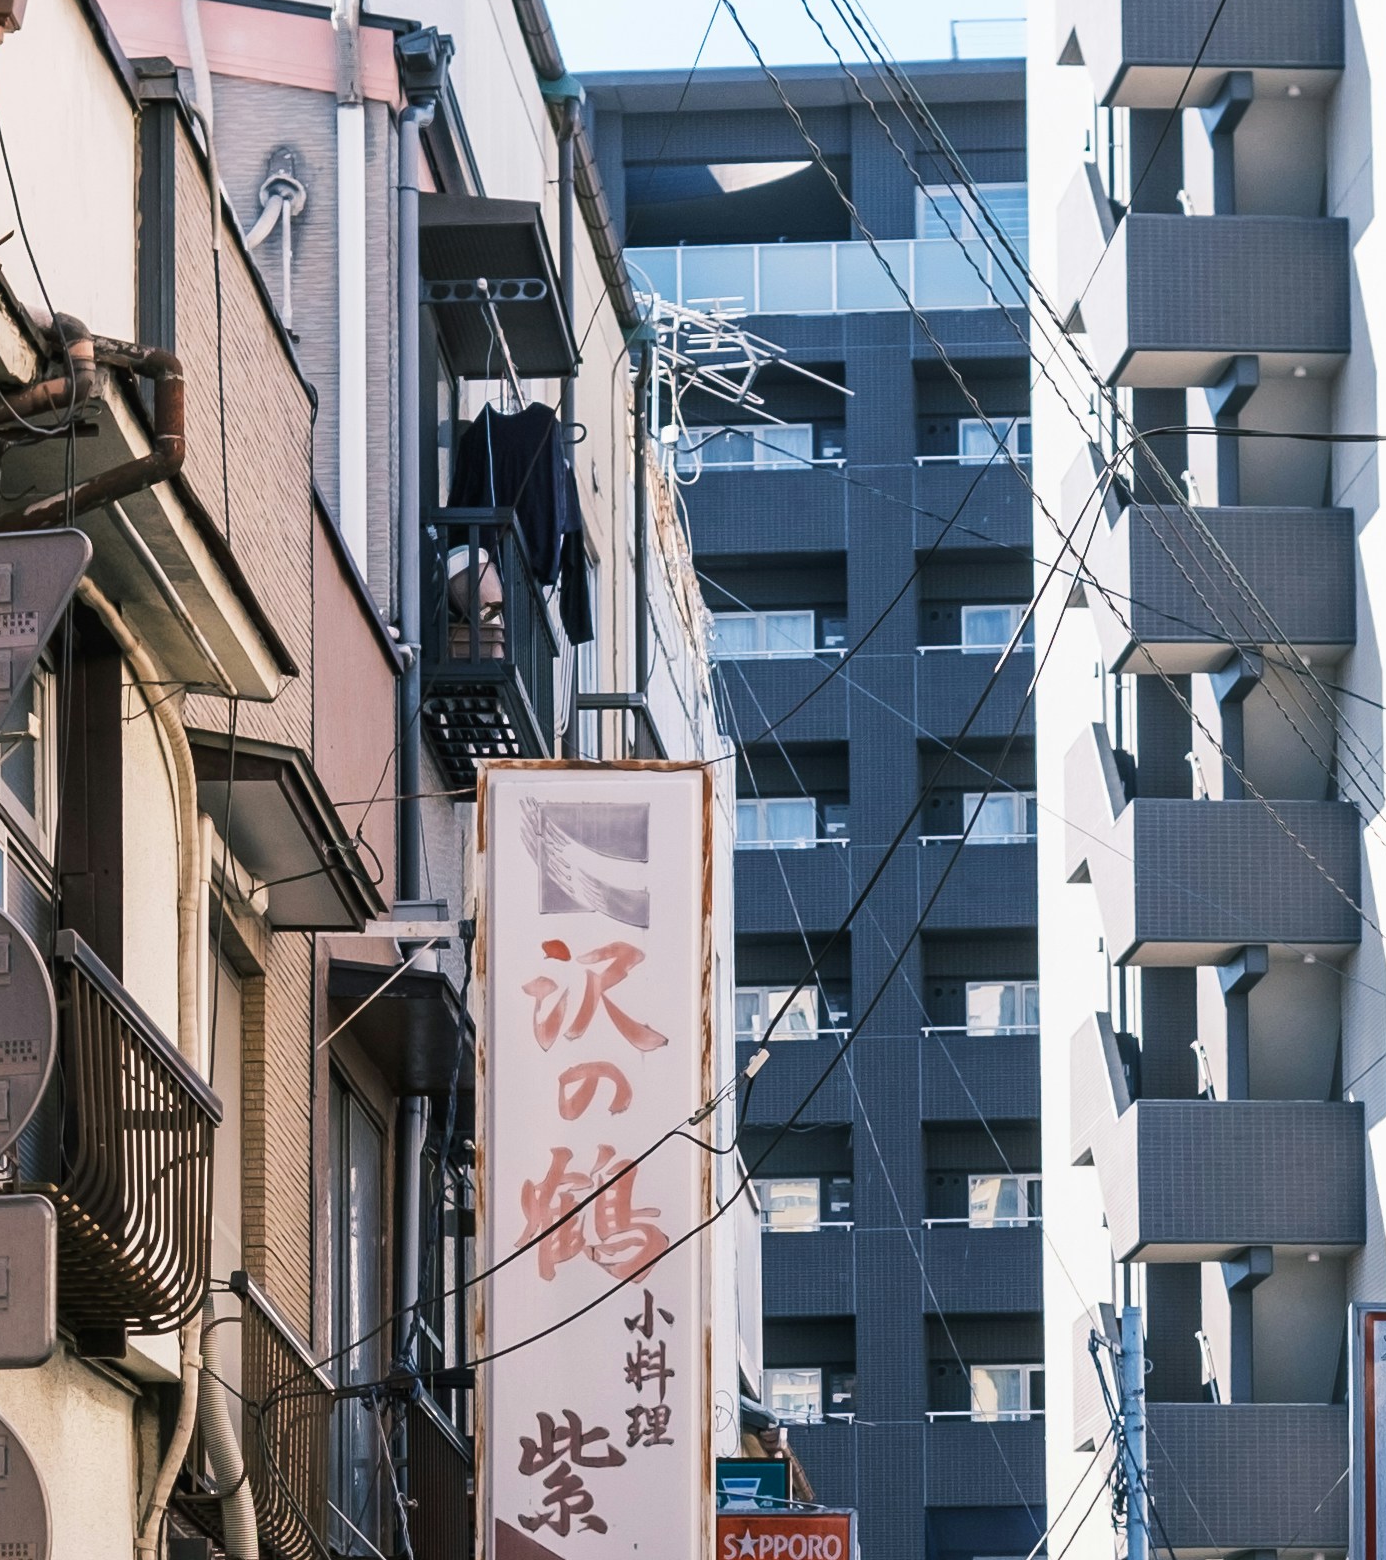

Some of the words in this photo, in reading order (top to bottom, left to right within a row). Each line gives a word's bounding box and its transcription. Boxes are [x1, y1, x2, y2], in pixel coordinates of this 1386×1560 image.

[515, 939, 670, 1283] 沢の鶴
[623, 1288, 675, 1448] 小料理
